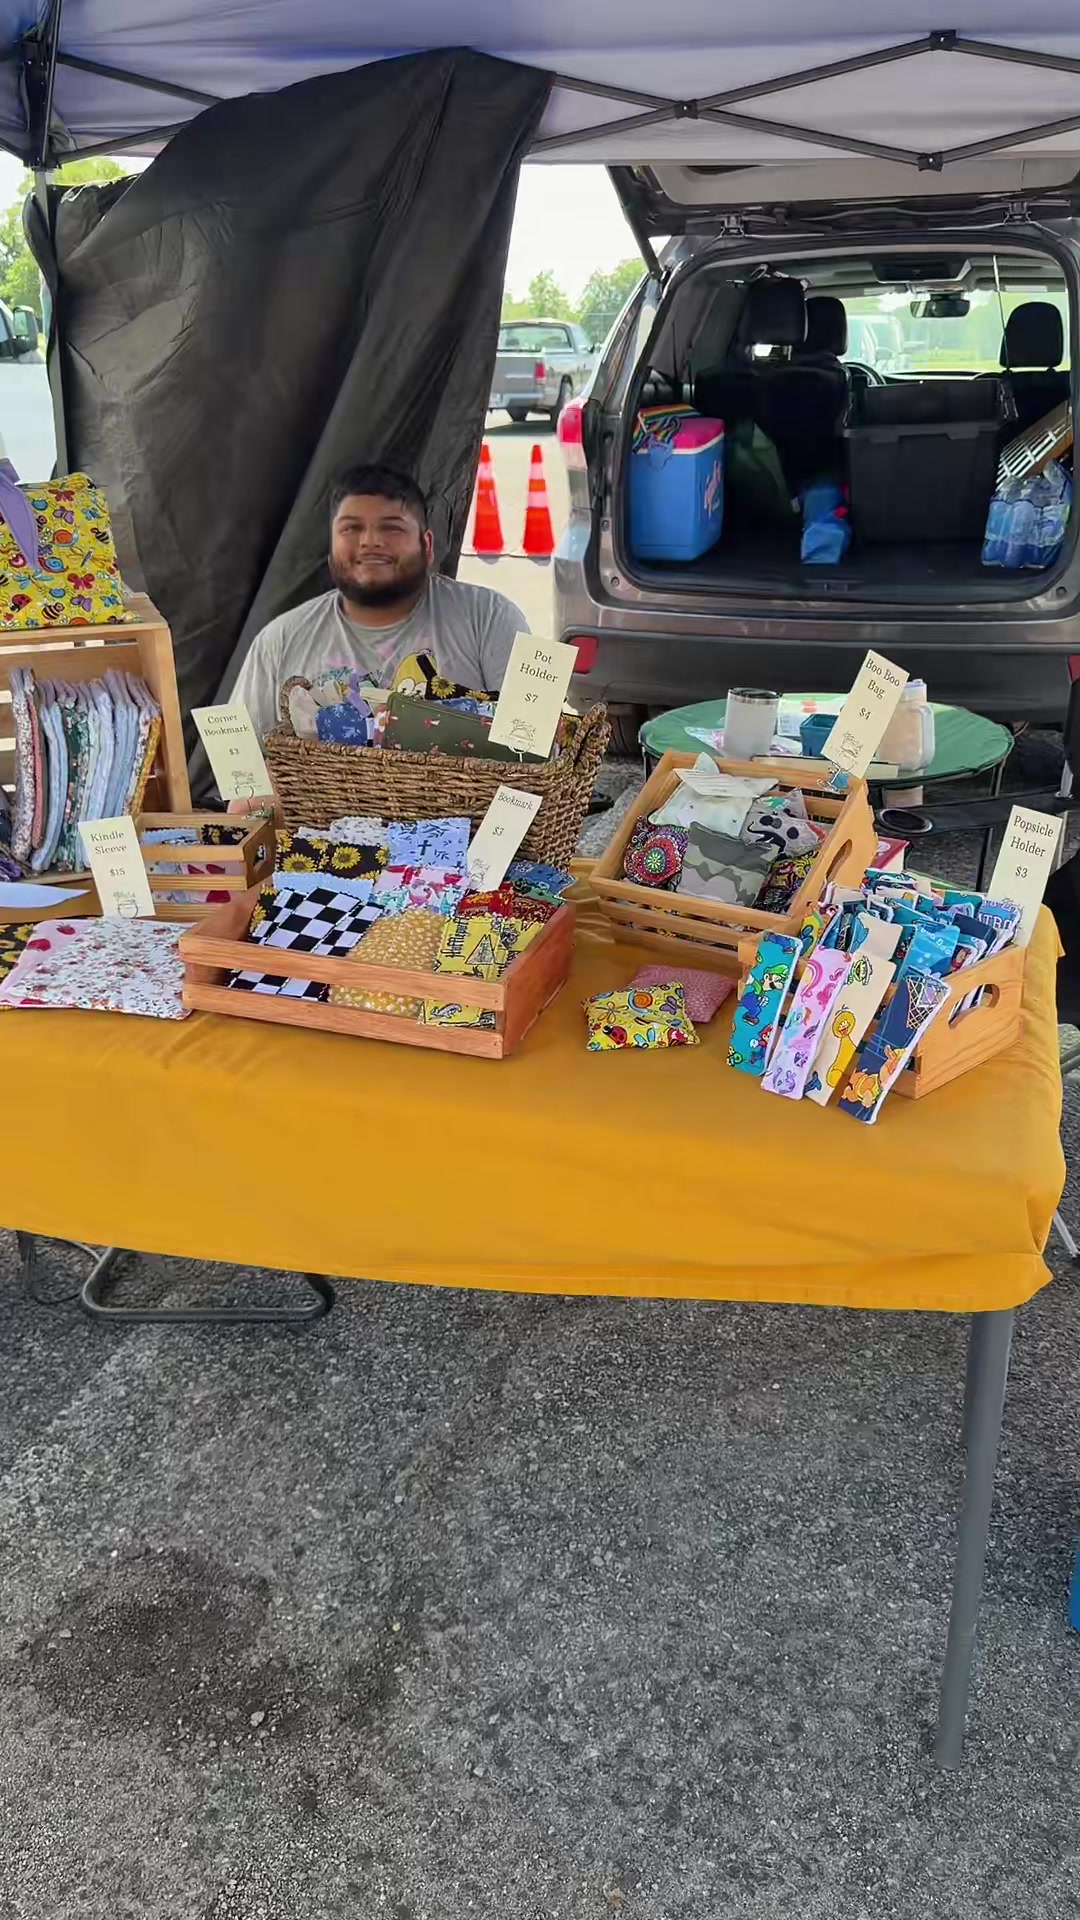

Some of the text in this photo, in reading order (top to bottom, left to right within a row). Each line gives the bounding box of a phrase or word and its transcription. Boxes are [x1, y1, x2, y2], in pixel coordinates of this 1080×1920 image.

[534, 650, 552, 664] Pot
[519, 662, 558, 683] Holder
[866, 658, 900, 687] Boo Boo
[867, 679, 885, 699] Bag
[524, 693, 538, 703] $7
[207, 714, 238, 724] Corner
[859, 707, 871, 720] $4
[204, 724, 249, 737] Bookmark
[229, 748, 240, 756] $3
[498, 791, 533, 810] Bookmark
[492, 826, 504, 836] $3
[1013, 814, 1054, 838] Popsicle
[90, 831, 125, 842] Kindle
[94, 845, 127, 855] Sleeve
[1010, 836, 1046, 857] Holder
[109, 867, 126, 877] $15
[1015, 864, 1028, 878] $3
